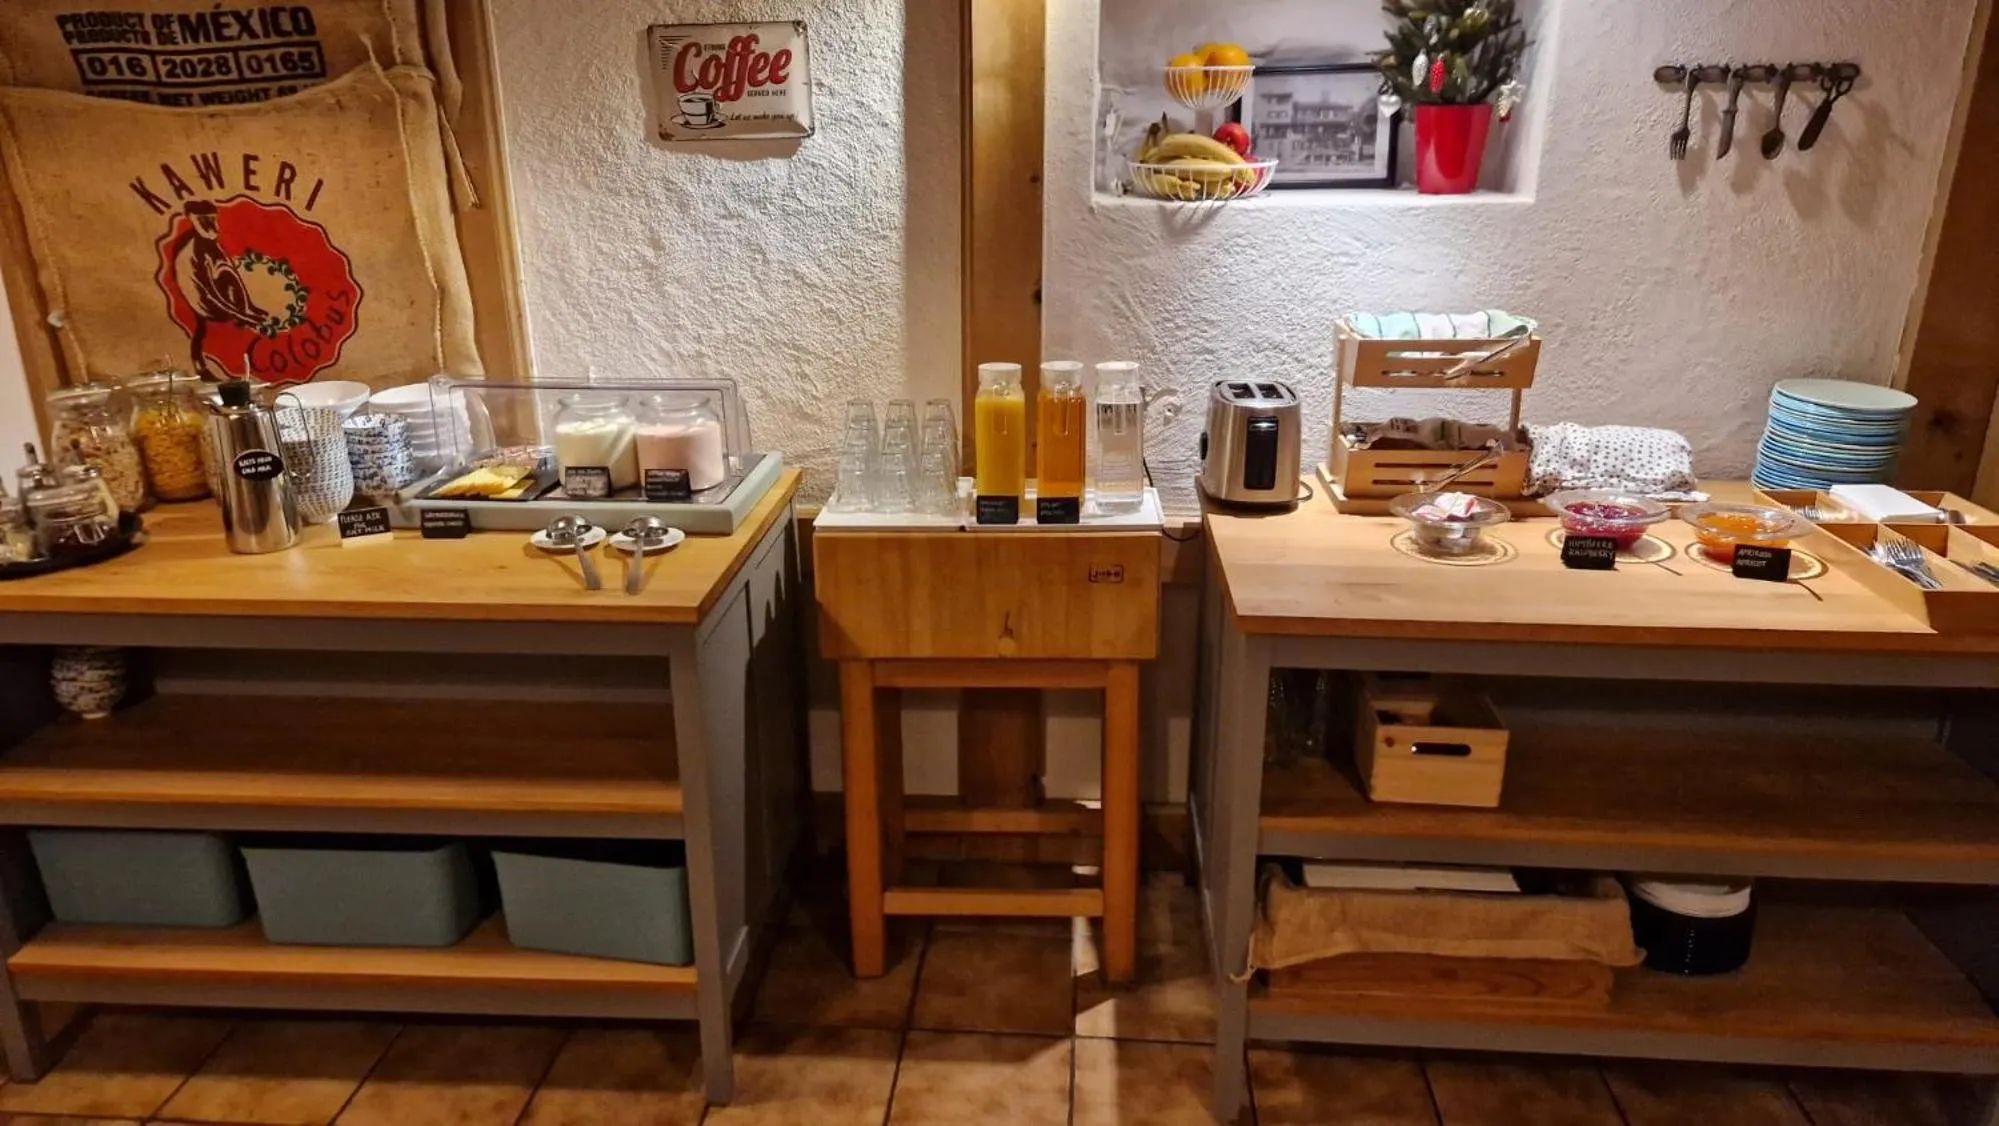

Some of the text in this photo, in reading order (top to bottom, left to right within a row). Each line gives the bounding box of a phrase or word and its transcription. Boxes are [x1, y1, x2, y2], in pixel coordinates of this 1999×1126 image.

[56, 12, 145, 30] PRODUCT
[177, 3, 317, 45] MÉXICO
[87, 51, 317, 80] 016 2028 0165
[673, 33, 793, 102] Coffee
[129, 151, 324, 215] KAWERI
